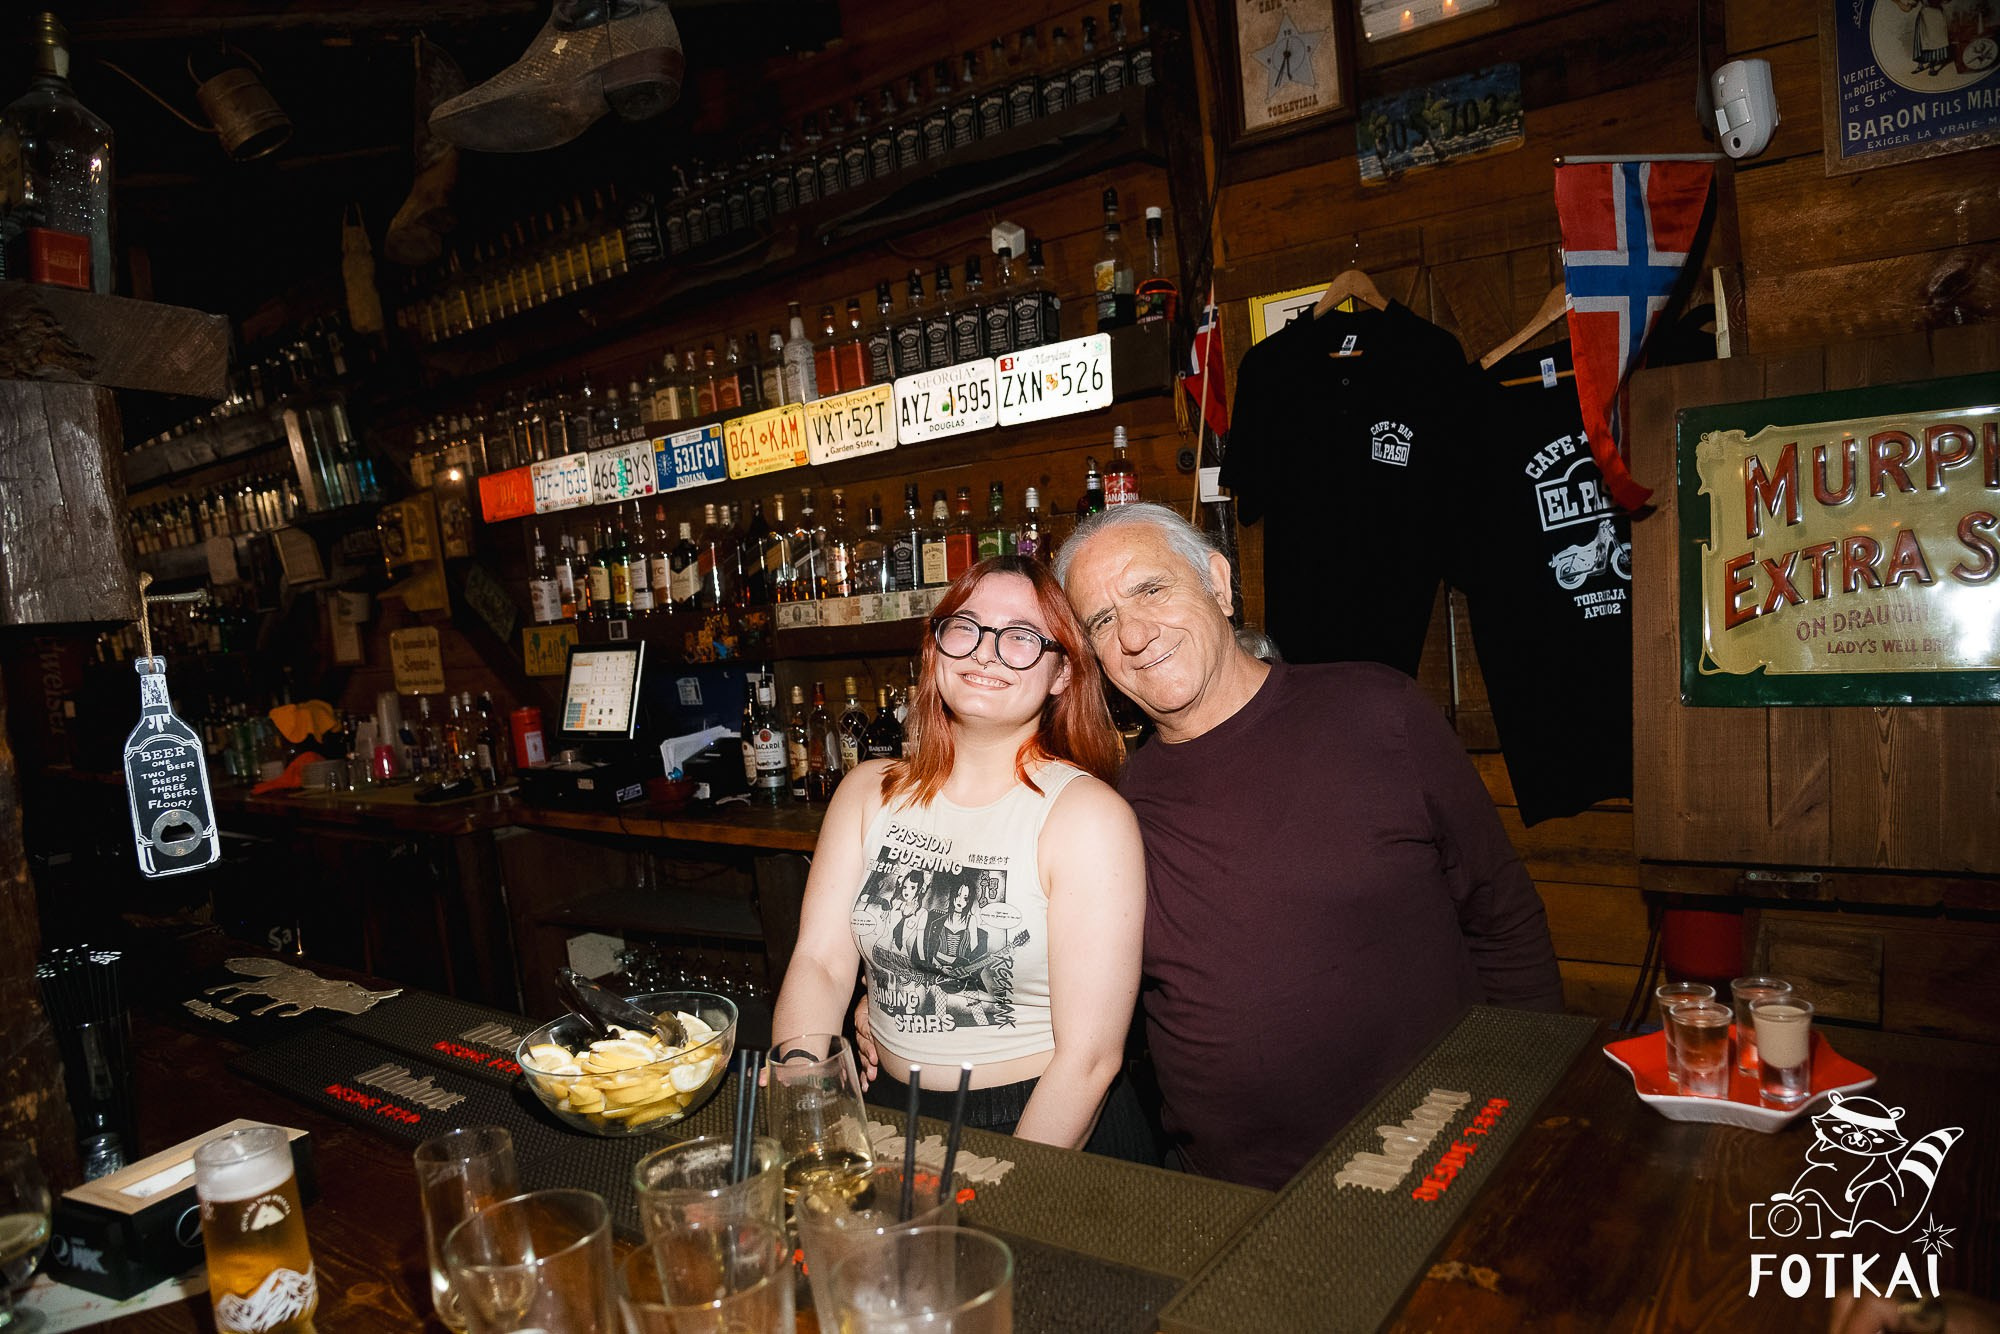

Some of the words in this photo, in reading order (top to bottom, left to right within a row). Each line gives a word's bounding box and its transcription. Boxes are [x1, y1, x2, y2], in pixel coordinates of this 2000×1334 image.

[1843, 65, 1877, 85] VENTE
[1849, 105, 1860, 114] DE
[1864, 95, 1876, 108] 5
[1848, 102, 1926, 142] BARON
[1932, 98, 1961, 119] FILS
[1867, 134, 1910, 149] EXIGER
[1917, 130, 1932, 140] LA
[916, 370, 972, 389] GEORGIA
[1001, 369, 1043, 408] ZXN
[1060, 358, 1104, 397] 526
[901, 392, 932, 428] AYZ
[948, 378, 992, 417] 1595
[812, 410, 843, 447] VXT
[851, 401, 886, 438] 52T
[928, 418, 966, 433] DOUGLAS
[1370, 420, 1390, 436] CAFE
[1397, 423, 1414, 441] BAR
[729, 428, 759, 462] 861
[768, 414, 800, 453] KAM
[830, 442, 855, 456] Garden
[856, 438, 874, 451] State
[673, 440, 720, 474] 531FCV
[1374, 444, 1383, 459] EL
[1383, 444, 1408, 463] PASO
[1525, 434, 1576, 480] CAFE
[593, 461, 617, 492] 466
[625, 454, 651, 486] BYS
[677, 471, 708, 485] INDIANA
[1542, 486, 1579, 522] EL
[1725, 529, 1934, 631] EXTRA
[1796, 615, 1826, 642] ON
[1827, 638, 1877, 654] LADY'S
[1882, 638, 1917, 653] WELL
[140, 746, 186, 762] BEER
[140, 770, 166, 780] TWO
[151, 759, 171, 768] ONE
[167, 761, 195, 772] BEER
[149, 783, 186, 795] THREE
[151, 773, 188, 786] BEERS
[163, 787, 198, 800] BEERS
[148, 799, 193, 810] FLOOR!
[886, 821, 953, 856] PASSION
[887, 845, 964, 876] BURNING
[894, 1013, 957, 1034] STARS
